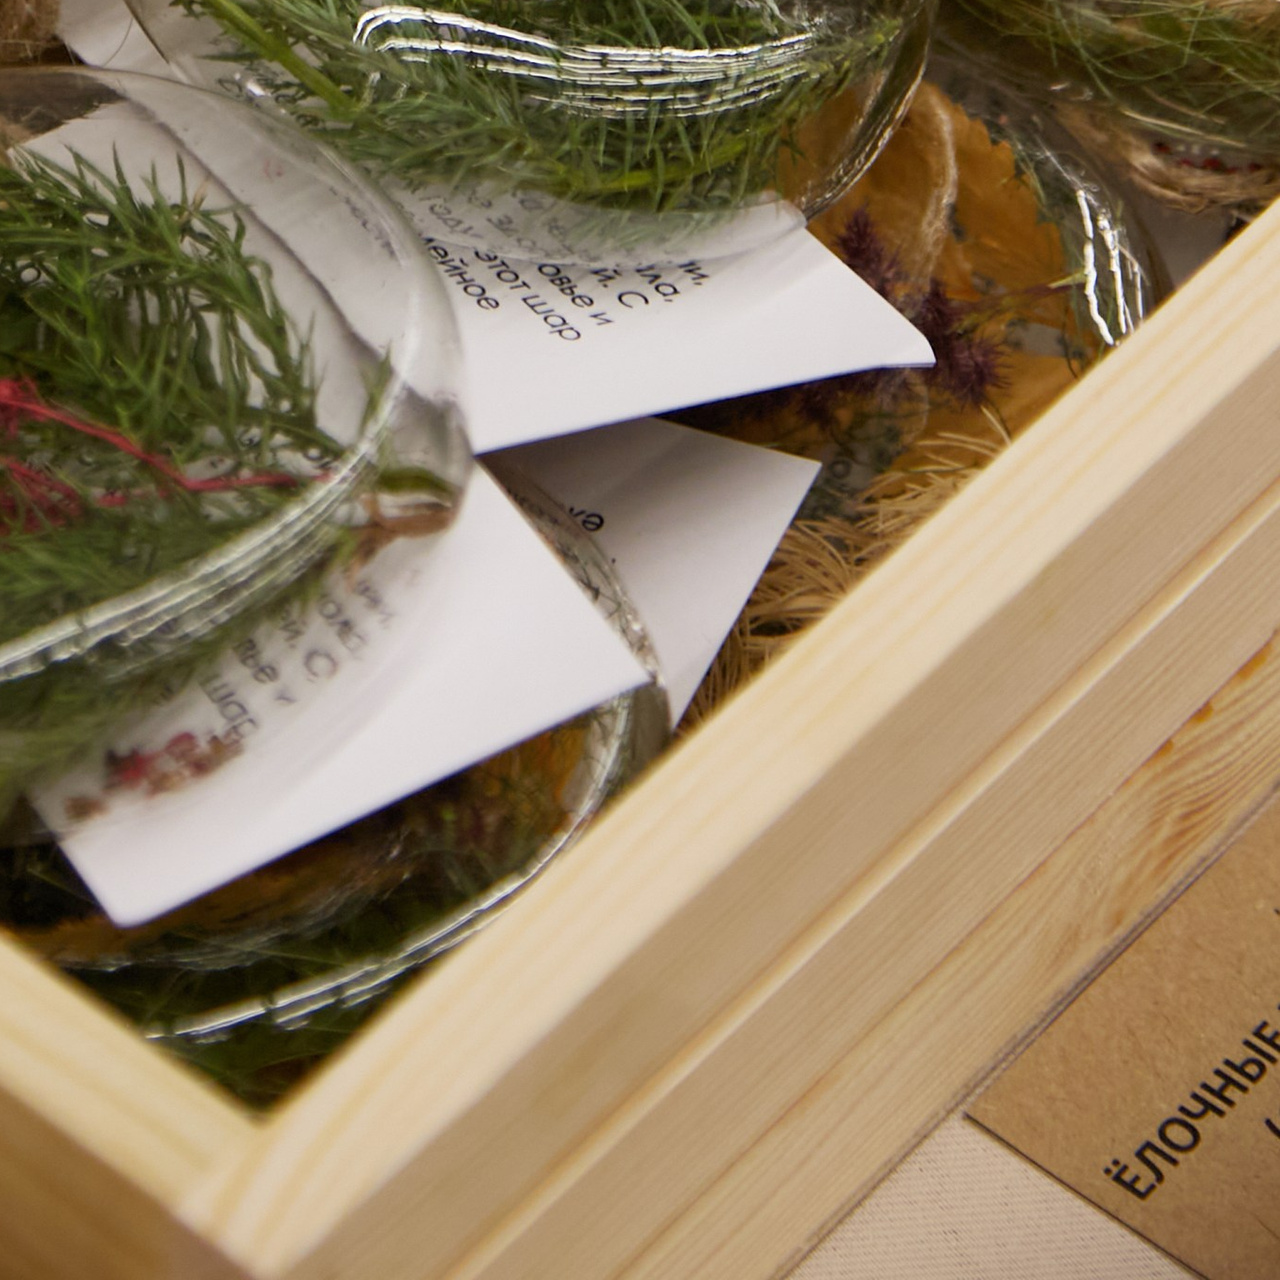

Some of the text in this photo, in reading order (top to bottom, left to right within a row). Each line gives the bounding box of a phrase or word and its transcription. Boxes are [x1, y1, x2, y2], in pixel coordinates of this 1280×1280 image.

[473, 248, 532, 291] этот
[520, 293, 582, 342] шар
[1103, 1020, 1280, 1200] ЁЛОЧНЫЕ
